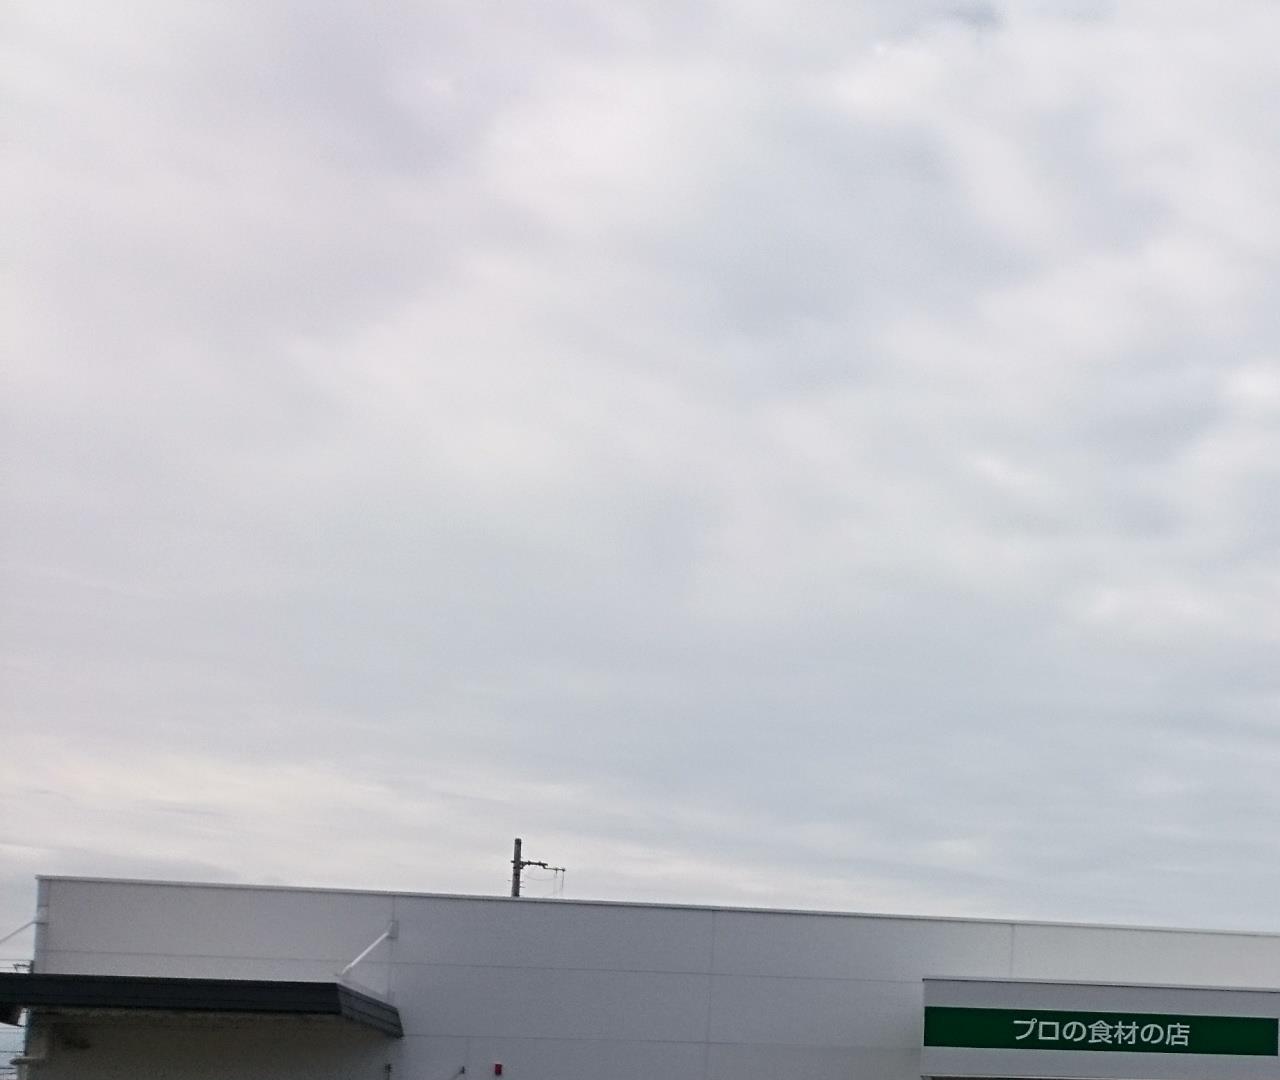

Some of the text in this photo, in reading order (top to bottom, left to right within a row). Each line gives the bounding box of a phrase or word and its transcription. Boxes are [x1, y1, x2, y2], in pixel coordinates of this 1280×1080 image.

[1013, 1019, 1190, 1047] プロの食材の店
